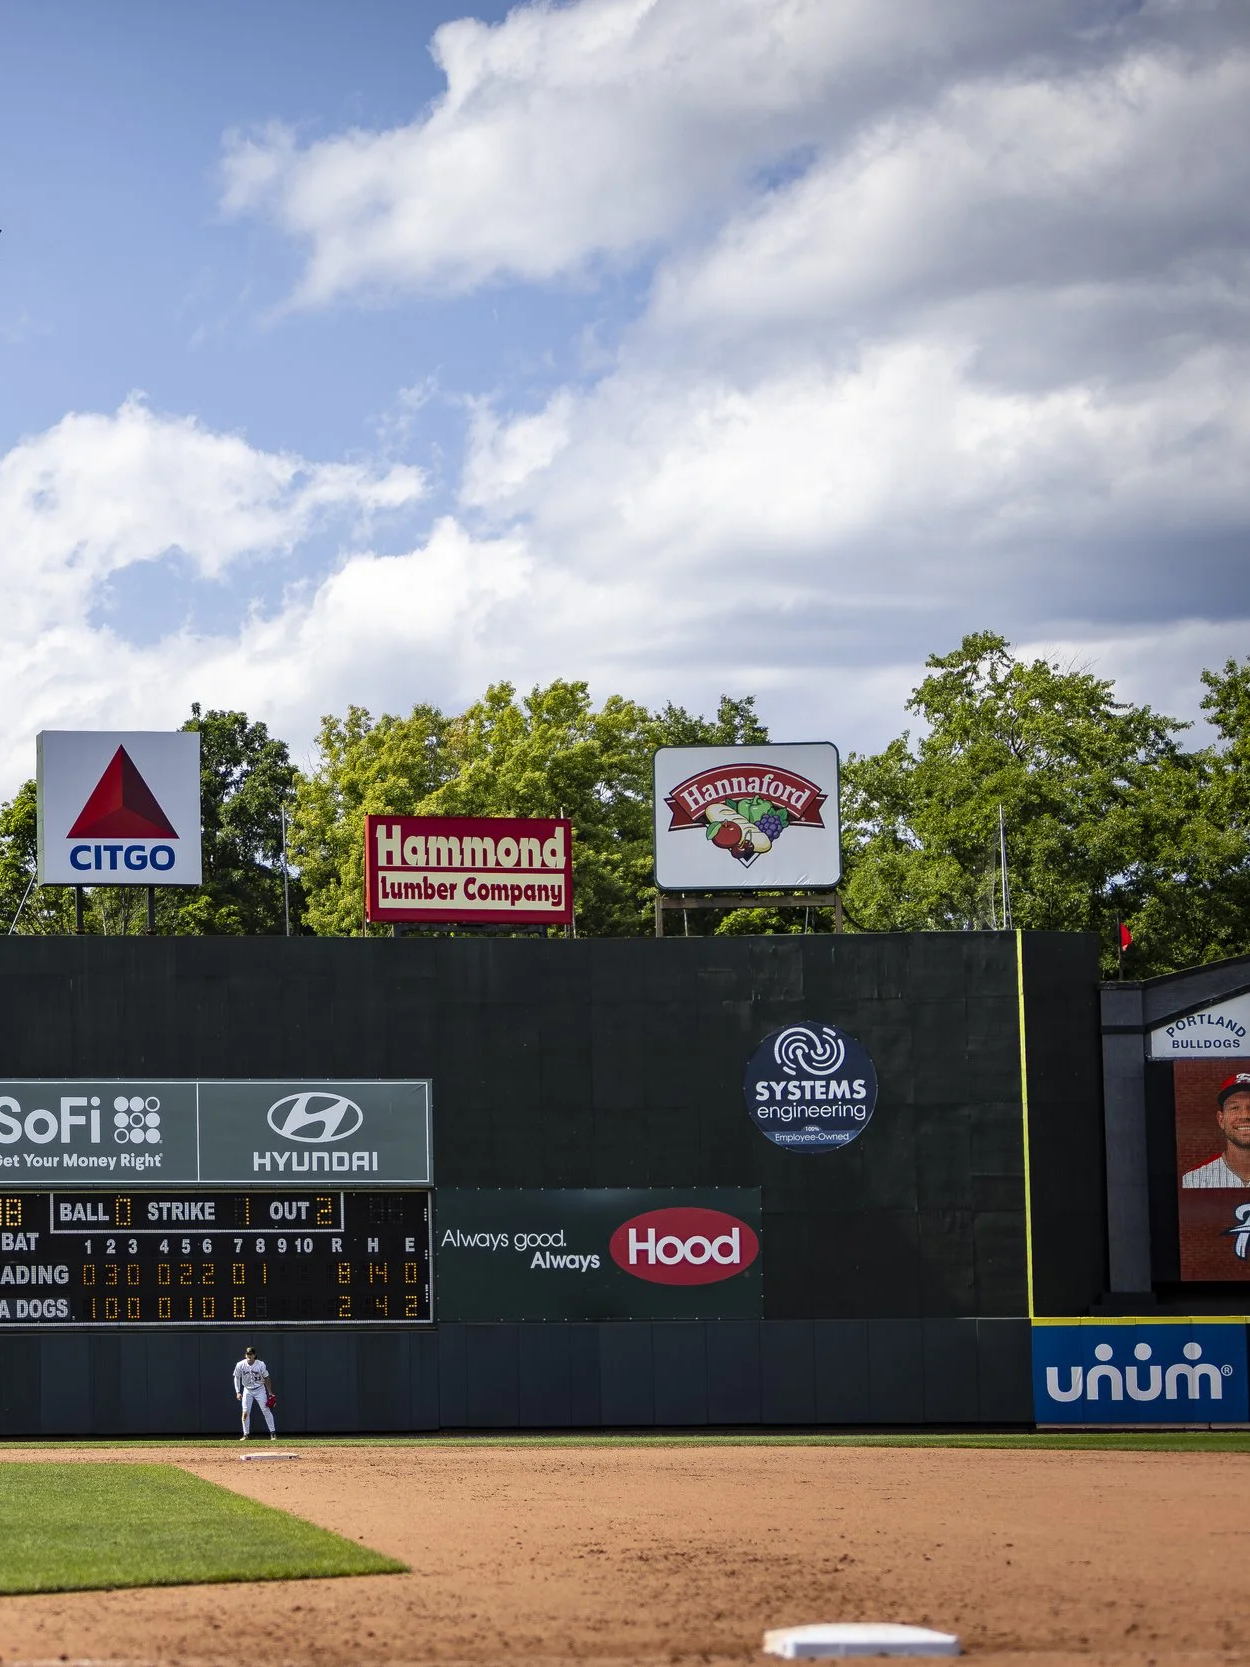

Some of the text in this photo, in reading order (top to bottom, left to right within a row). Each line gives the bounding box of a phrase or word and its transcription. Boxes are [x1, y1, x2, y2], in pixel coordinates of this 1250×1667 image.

[680, 774, 811, 811] Hannaford
[70, 845, 175, 870] CITGO
[376, 825, 566, 869] Hammond
[381, 876, 562, 906] Lumber Company
[1166, 1014, 1246, 1038] PORTLAND
[1172, 1039, 1240, 1048] BULLDOGS
[755, 1079, 866, 1100] SYSTEMS
[757, 1102, 866, 1121] engineering
[775, 1133, 849, 1142] Employee-Owned
[23, 1154, 59, 1167] Your
[63, 1154, 117, 1170] Money
[253, 1151, 378, 1172] HYUNDAI
[59, 1202, 109, 1221] BALL
[116, 1198, 131, 1226] 0
[148, 1202, 216, 1221] STRIKE
[269, 1201, 310, 1220] OUT
[317, 1197, 332, 1225] 2
[1, 1232, 39, 1250] BAT
[84, 1237, 415, 1254] 1 2 3 4 5 6 7 8 9 10 R H E
[441, 1229, 566, 1251] Always good.
[628, 1227, 741, 1265] Hood
[530, 1251, 600, 1272] Always
[83, 1264, 95, 1285] 0
[105, 1264, 117, 1285] 3
[127, 1264, 140, 1285] 0
[158, 1264, 170, 1285] 0
[180, 1264, 192, 1285] 2
[202, 1263, 214, 1284] 2
[232, 1263, 245, 1284] 0
[338, 1262, 350, 1283] 8
[369, 1262, 387, 1283] 14
[405, 1262, 417, 1283] 0
[16, 1299, 69, 1318] DOGS
[105, 1298, 117, 1319] 0
[127, 1298, 140, 1319] 0
[158, 1298, 170, 1318] 0
[202, 1297, 215, 1318] 0
[339, 1296, 351, 1317] 2
[376, 1296, 387, 1316] 4
[405, 1296, 417, 1316] 2
